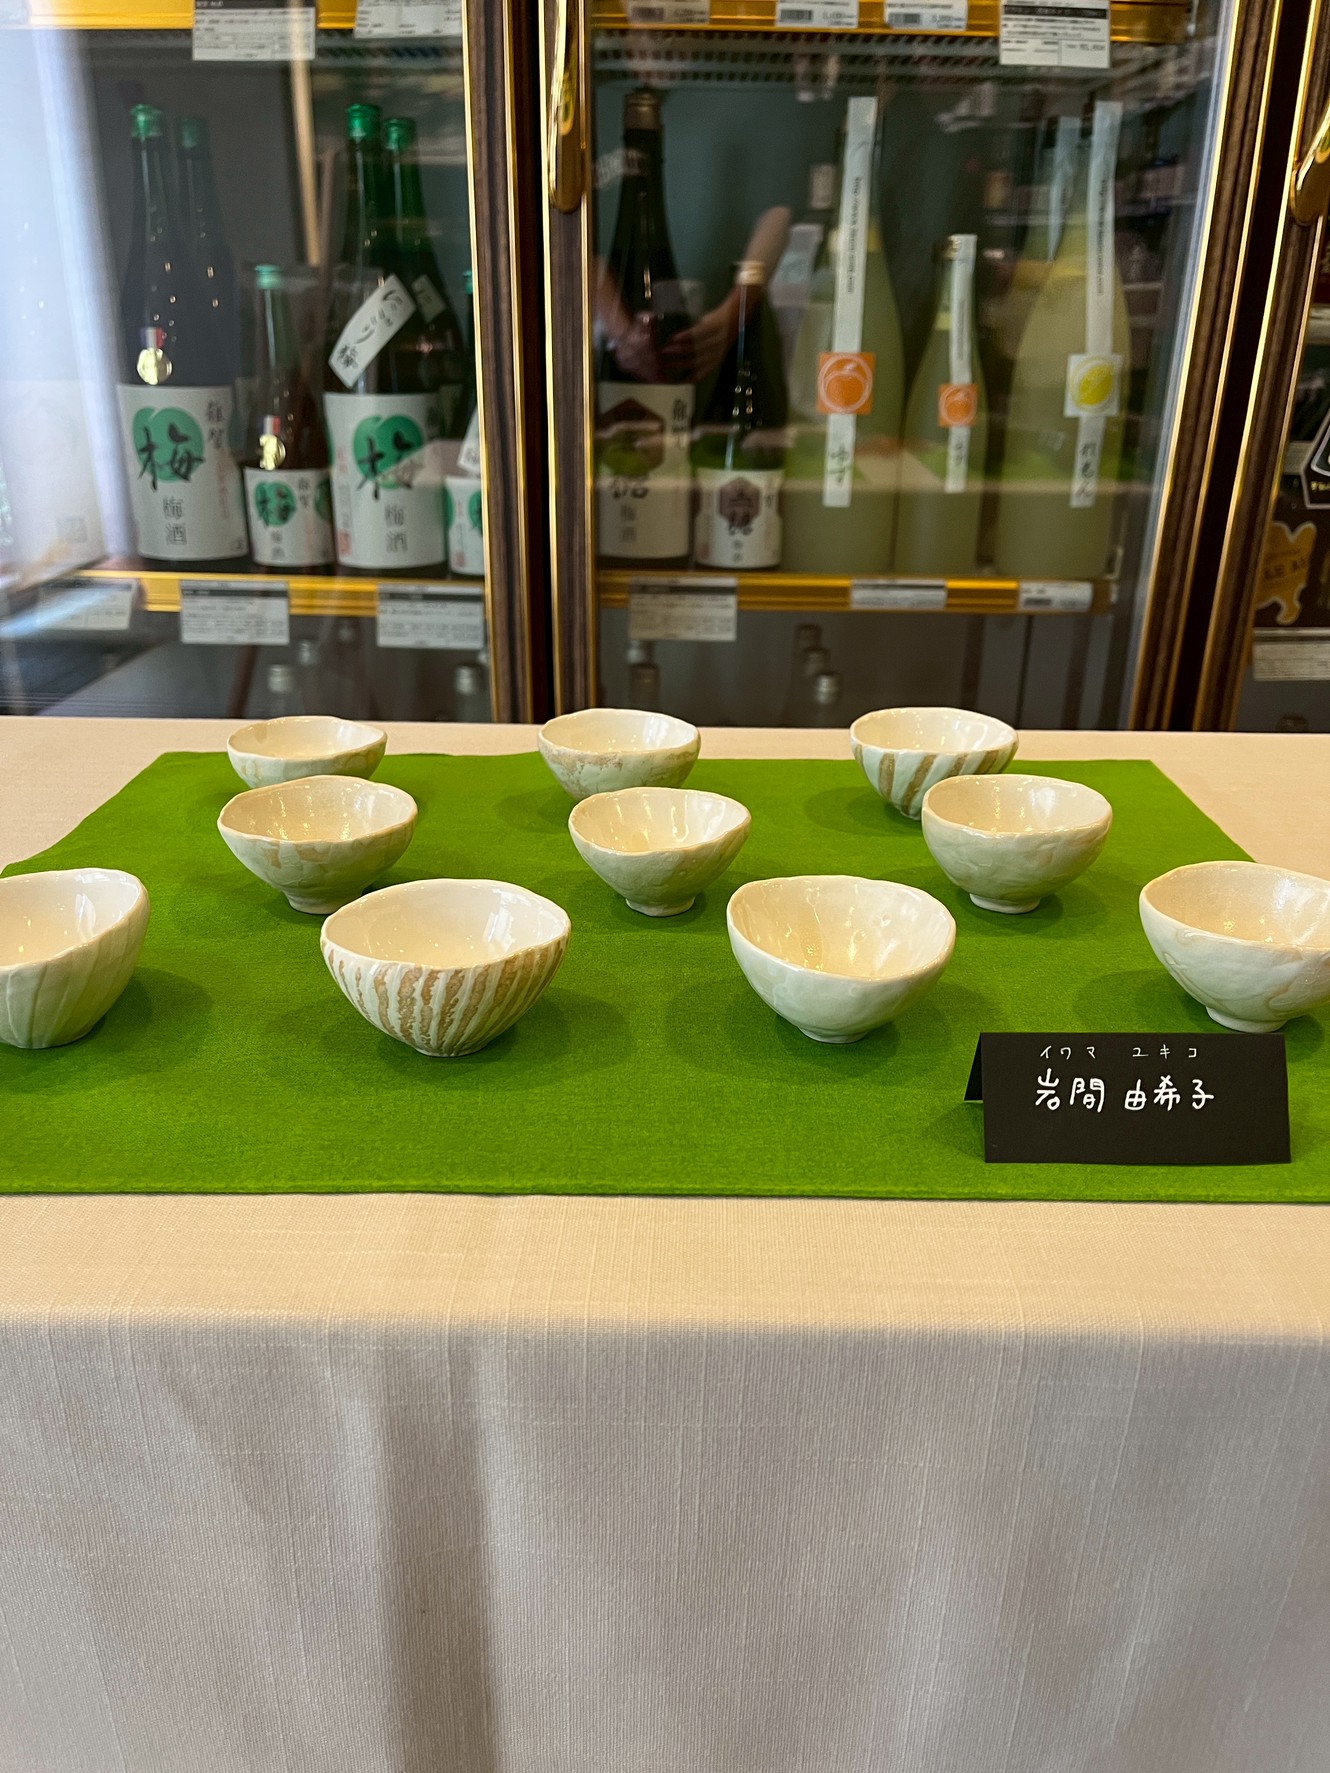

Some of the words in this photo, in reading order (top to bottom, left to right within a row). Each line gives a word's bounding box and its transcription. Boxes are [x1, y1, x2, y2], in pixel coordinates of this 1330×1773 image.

[137, 421, 206, 491] 梅
[162, 497, 188, 546] 梅酒
[1039, 1045, 1096, 1060] イワマ
[1132, 1043, 1197, 1059] ユキコ
[1034, 1067, 1105, 1113] 岩間
[1124, 1074, 1215, 1112] 由希子
